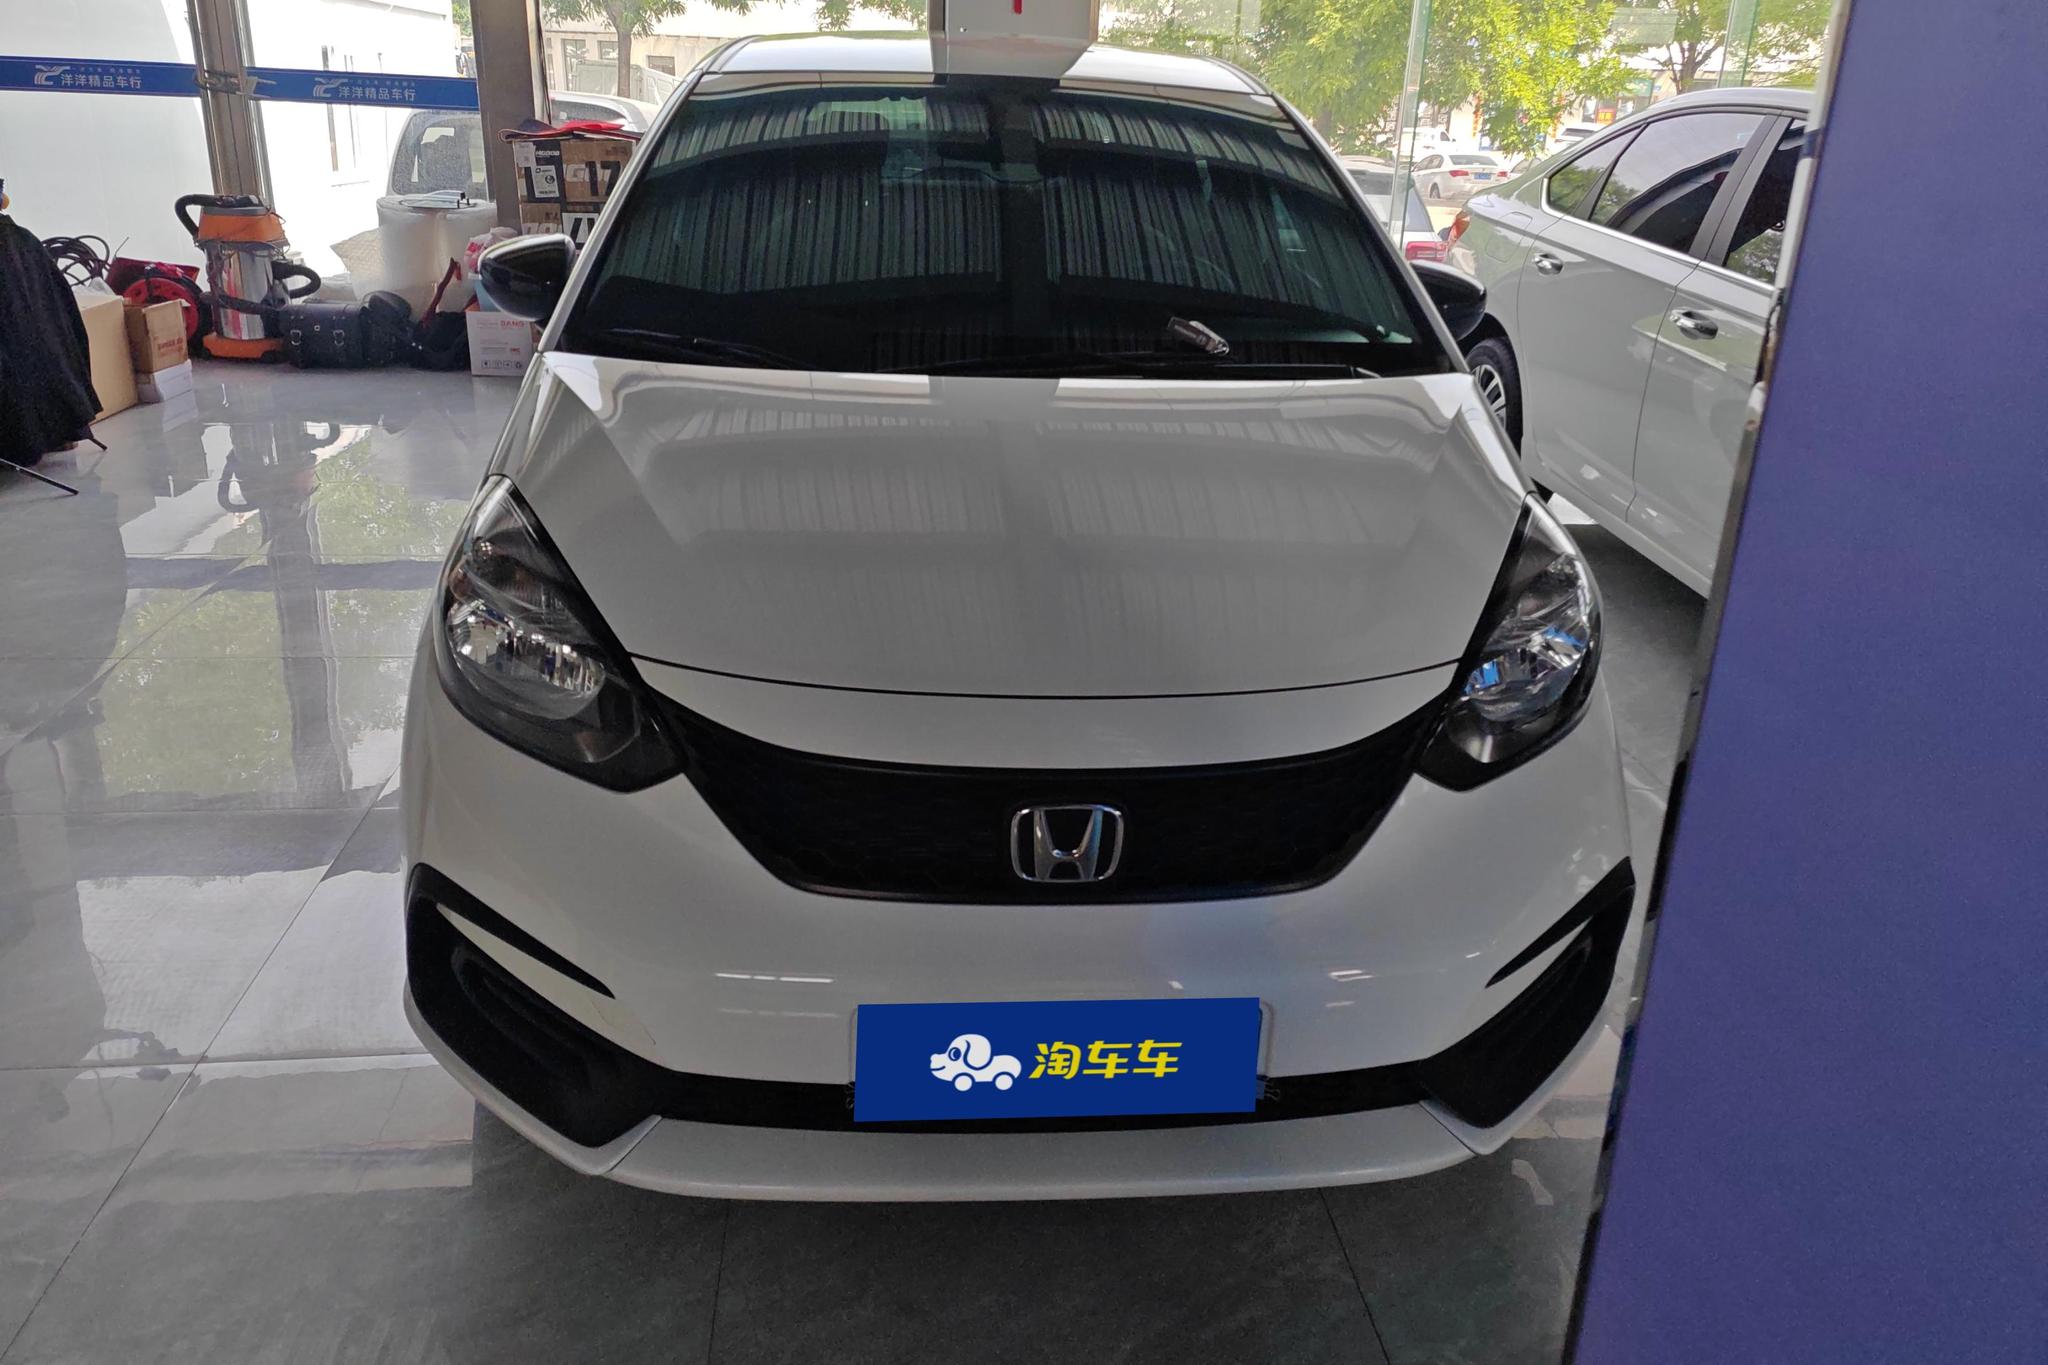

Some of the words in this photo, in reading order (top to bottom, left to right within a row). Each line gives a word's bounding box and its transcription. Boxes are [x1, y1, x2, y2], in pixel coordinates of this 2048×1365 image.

[60, 73, 142, 89] 洋洋精品车行
[338, 86, 416, 101] 洋洋精品车行
